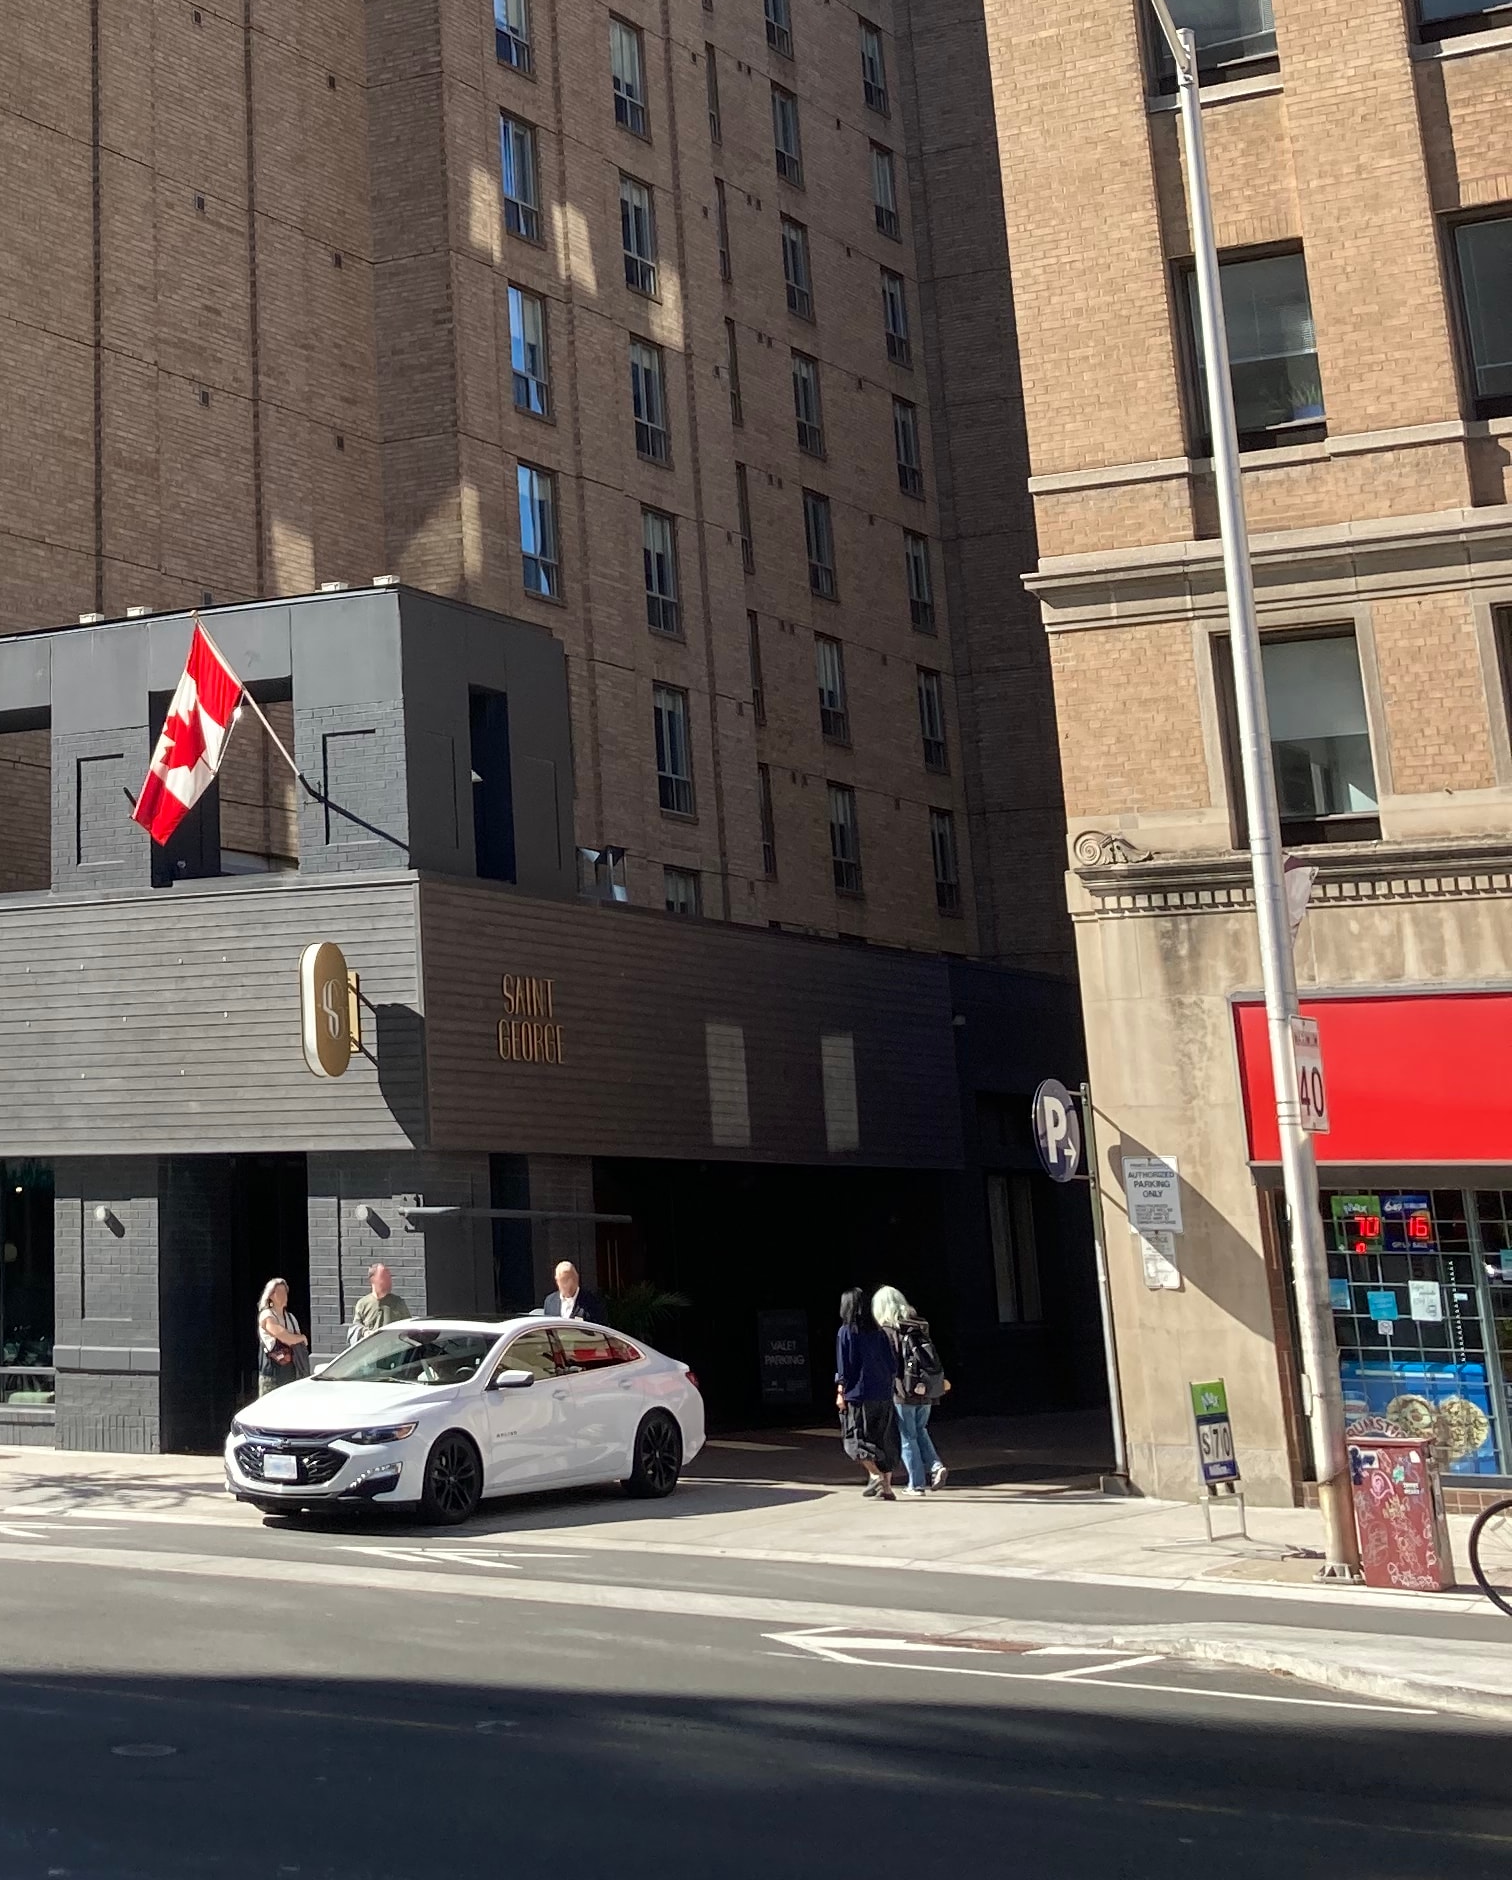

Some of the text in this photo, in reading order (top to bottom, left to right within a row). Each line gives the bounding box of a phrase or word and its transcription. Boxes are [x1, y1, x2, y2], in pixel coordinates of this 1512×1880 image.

[502, 973, 556, 1018] SAINT
[498, 1018, 566, 1064] GEORGE
[1300, 1065, 1324, 1117] 40
[1043, 1096, 1067, 1163] P
[1128, 1171, 1175, 1179] AUTHORIZED
[1133, 1180, 1171, 1188] PARKING
[1142, 1190, 1163, 1198] ONLY
[1354, 1216, 1380, 1237] 70
[1409, 1216, 1429, 1237] 16
[770, 1340, 796, 1351] VALET
[764, 1354, 805, 1365] PARKING
